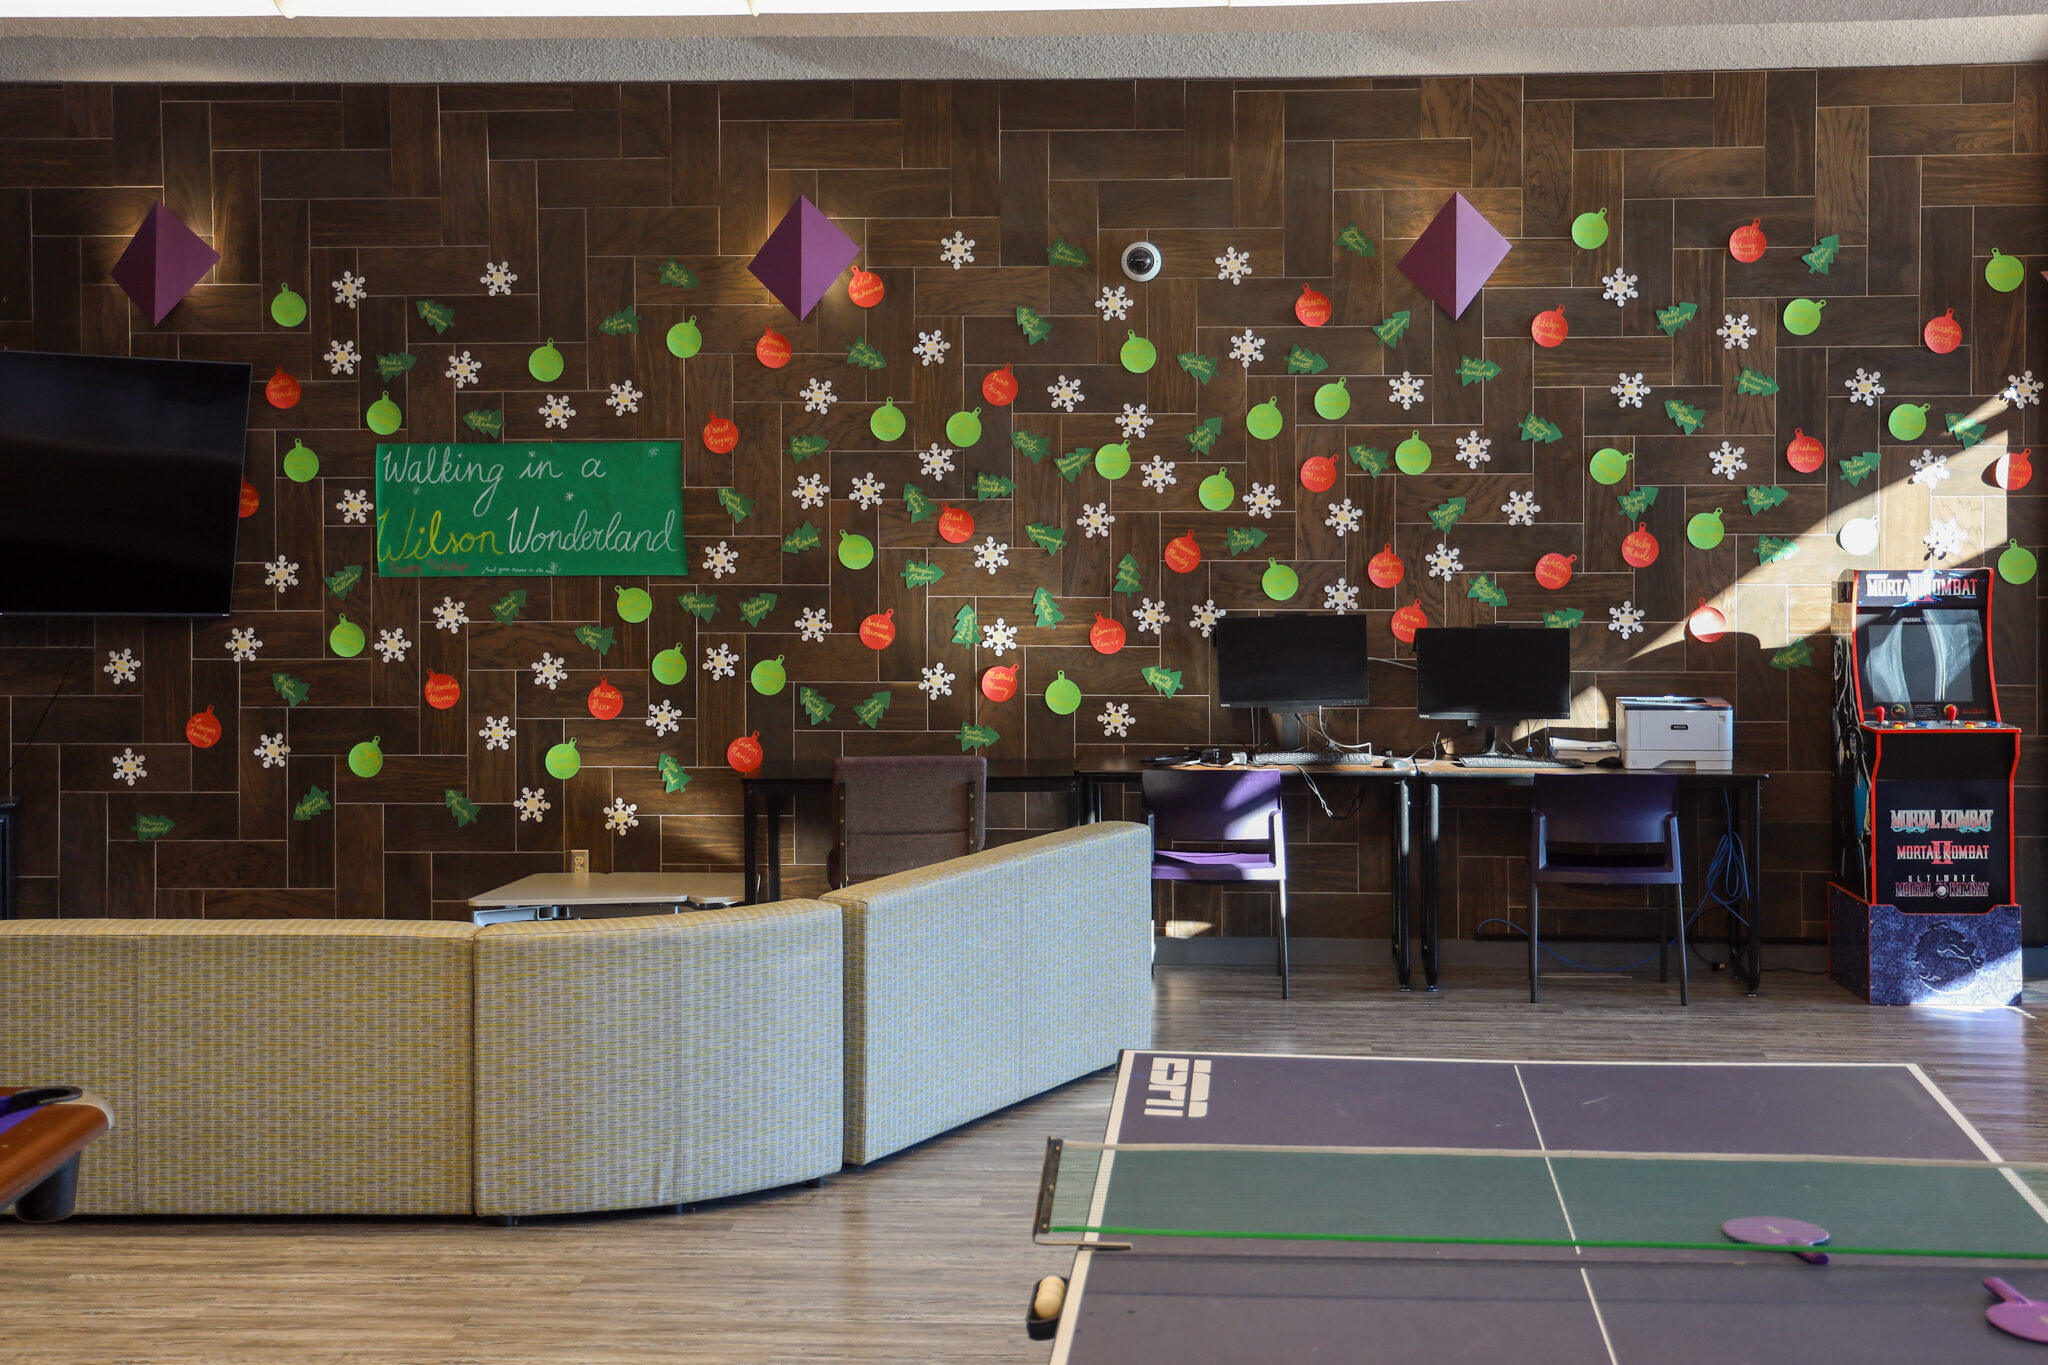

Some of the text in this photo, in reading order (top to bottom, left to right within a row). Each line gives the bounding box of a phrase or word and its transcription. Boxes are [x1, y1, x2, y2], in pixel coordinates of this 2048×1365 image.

[383, 446, 606, 517] Walking in a
[377, 506, 678, 562] Wilson Wonderland
[1866, 579, 1919, 597] MORTA
[1920, 578, 1978, 596] OMBAT
[1890, 809, 1994, 830] MORTAL KOMBAT
[1897, 845, 1989, 860] MORTAL KOMBAT
[1908, 874, 1975, 882] ULTIMATE
[1895, 881, 1934, 897] MORTAL
